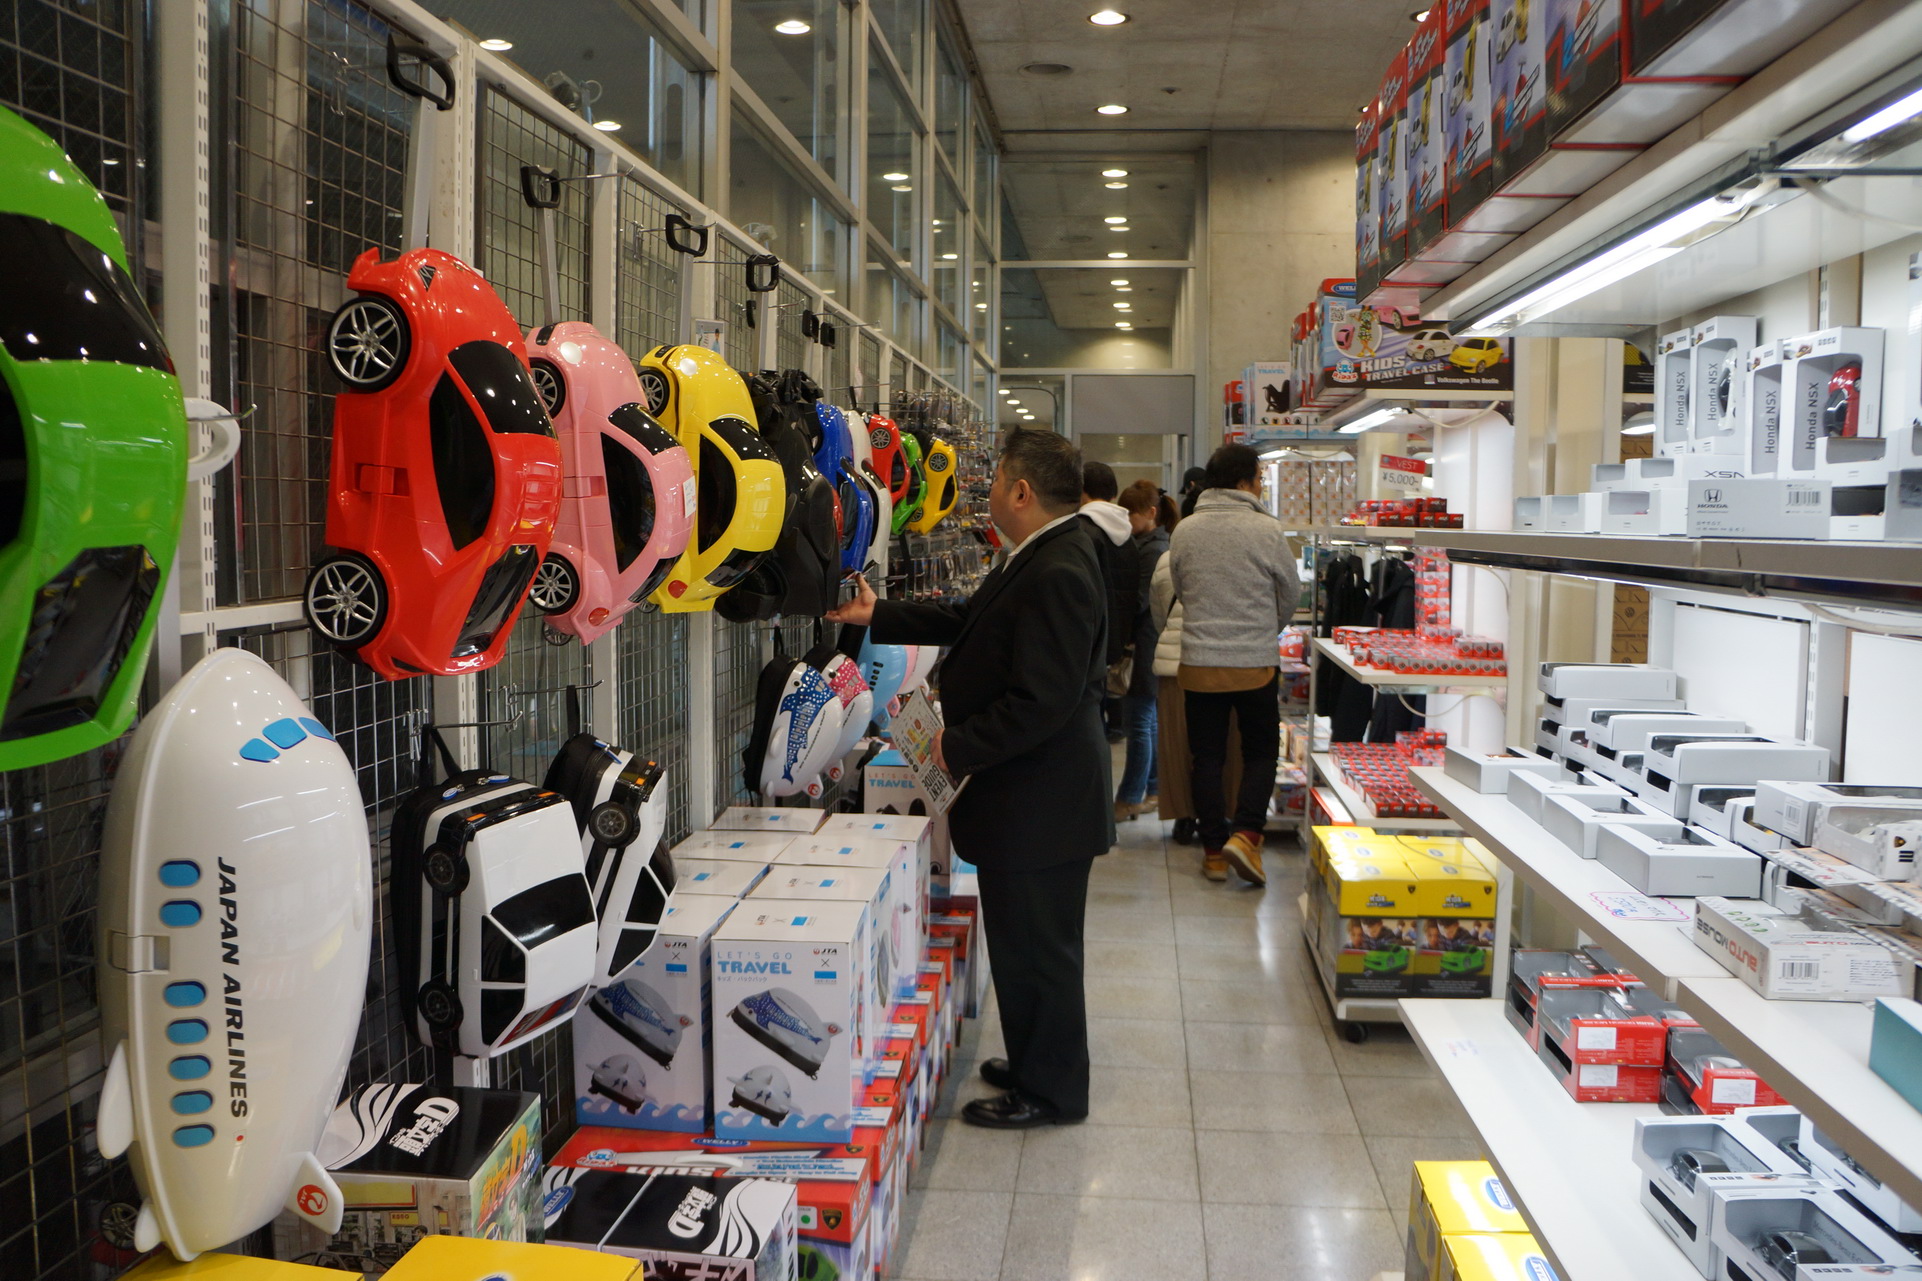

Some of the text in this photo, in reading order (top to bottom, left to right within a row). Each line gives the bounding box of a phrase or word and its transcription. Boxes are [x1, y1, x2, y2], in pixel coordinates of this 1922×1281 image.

[1361, 356, 1406, 373] KIDS
[1365, 362, 1445, 382] TRAVEL CASE
[1675, 371, 1686, 426] Honda NSX
[1707, 363, 1718, 421] Honda NSX
[1764, 390, 1777, 454] Honda NSX
[1805, 382, 1819, 450] Honda NSX
[1396, 459, 1418, 470] VEST
[869, 778, 915, 789] TRAVEL
[921, 764, 940, 791] GUIDE
[929, 775, 948, 802] EVENT
[717, 951, 792, 960] LET'S GO
[717, 960, 792, 975] TRAVEL
[217, 856, 248, 1119] JAPAN AIRLINES
[701, 1138, 742, 1146] WELLY
